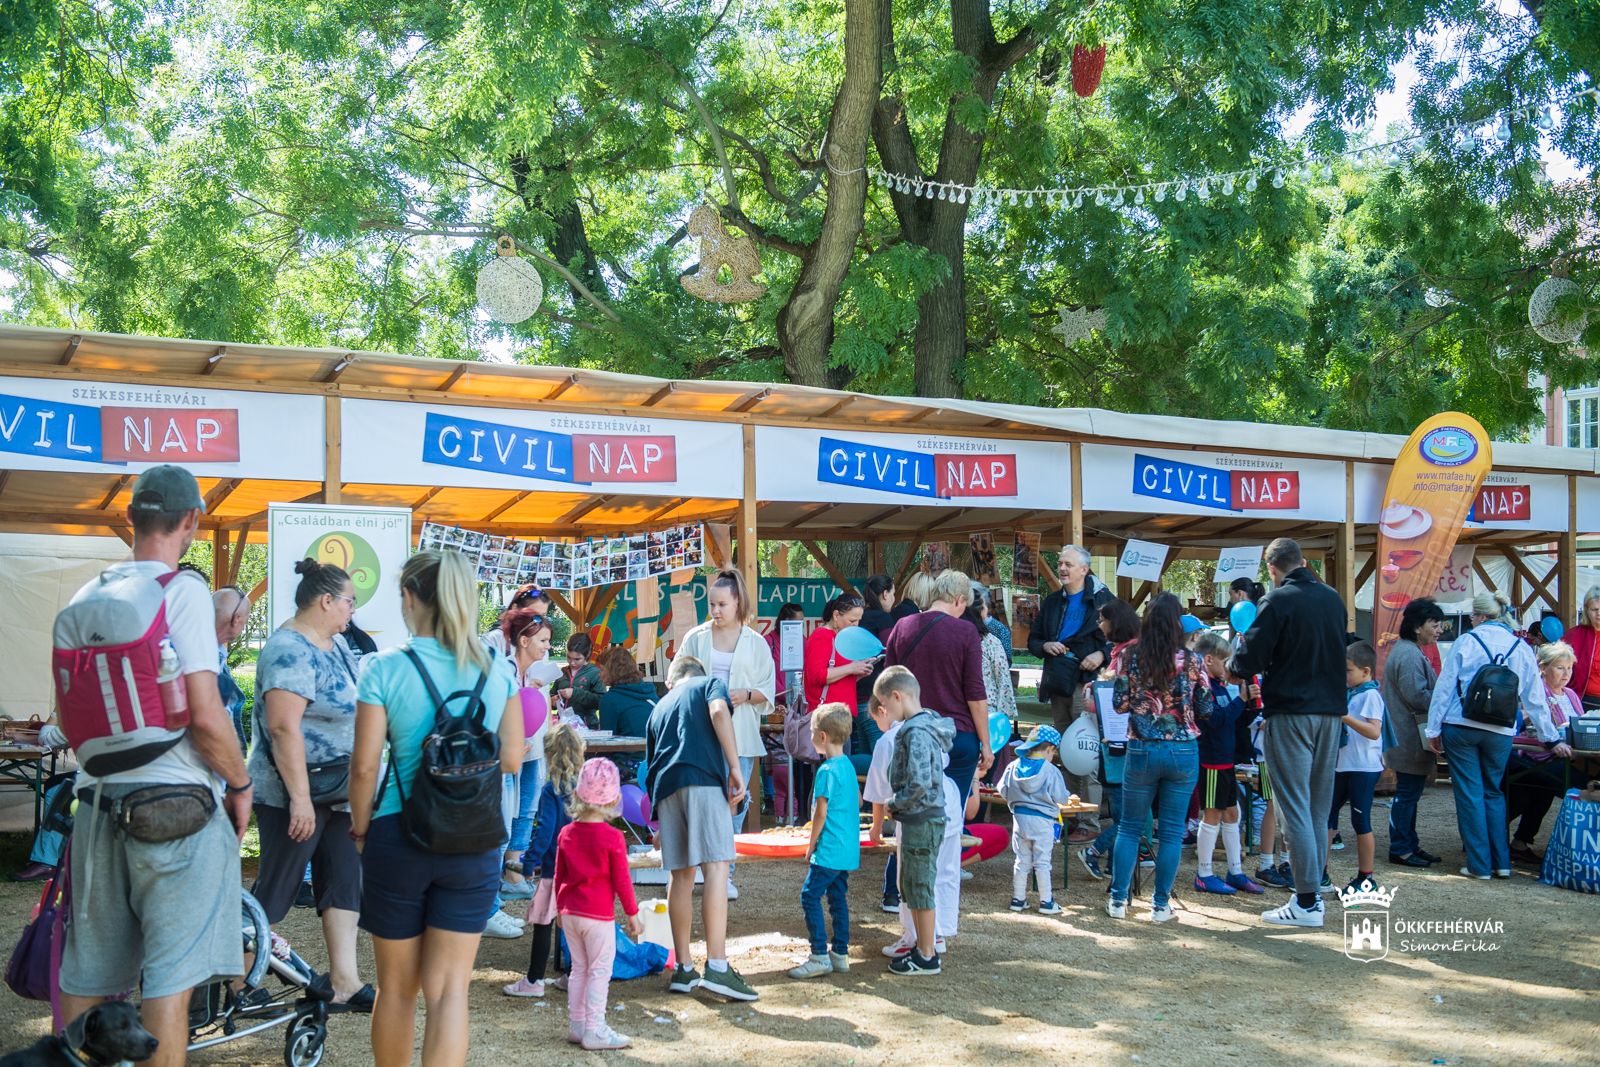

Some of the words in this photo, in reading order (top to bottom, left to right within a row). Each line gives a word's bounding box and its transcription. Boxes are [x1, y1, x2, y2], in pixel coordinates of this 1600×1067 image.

[72, 388, 207, 406] SZÉKESFEHÉRVÁRI
[550, 418, 651, 433] SZÉKESFEHÉRVÁRI
[123, 416, 222, 453] NAP
[438, 425, 567, 475] CIVIL
[589, 442, 663, 474] NAP
[917, 438, 997, 452] SZÉKESFEHÉRVÁRI
[830, 448, 930, 491] CIVIL
[947, 460, 1006, 489] NAP
[1215, 457, 1283, 470] SZÉKESFEHÉRVÁRI
[1142, 464, 1227, 503] CIVIL
[1241, 477, 1291, 503] NAP
[1416, 471, 1476, 482] www.mafae.hu
[1413, 481, 1476, 493] info@mafae.hu
[1483, 491, 1524, 515] NAP
[355, 518, 378, 528] élni
[759, 581, 837, 603] LAPÍTV
[1078, 740, 1099, 753] ZETA
